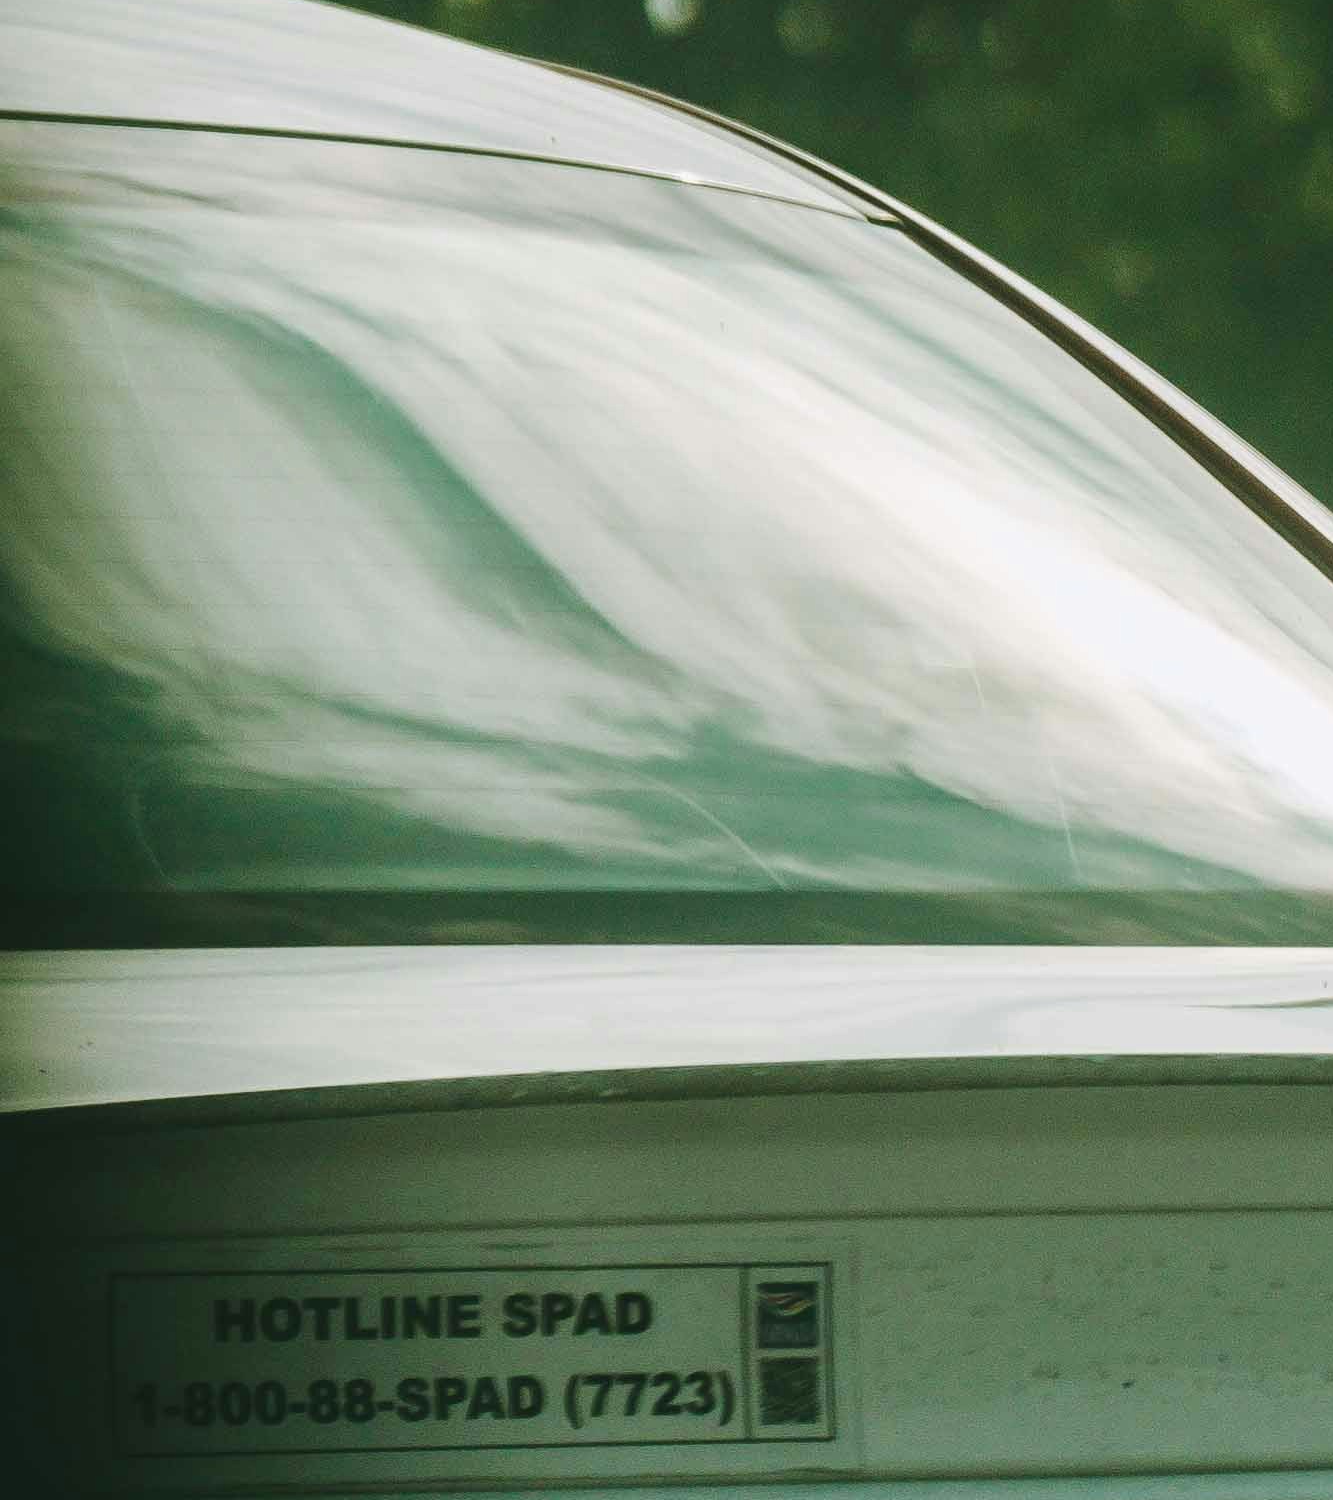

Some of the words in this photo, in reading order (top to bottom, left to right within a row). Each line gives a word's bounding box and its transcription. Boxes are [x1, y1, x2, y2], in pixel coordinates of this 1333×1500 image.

[213, 1295, 481, 1344] HOTLINE
[501, 1290, 654, 1337] SPAD
[131, 1375, 545, 1428] 1-800-88-SPAD
[564, 1369, 736, 1429] (7723)
